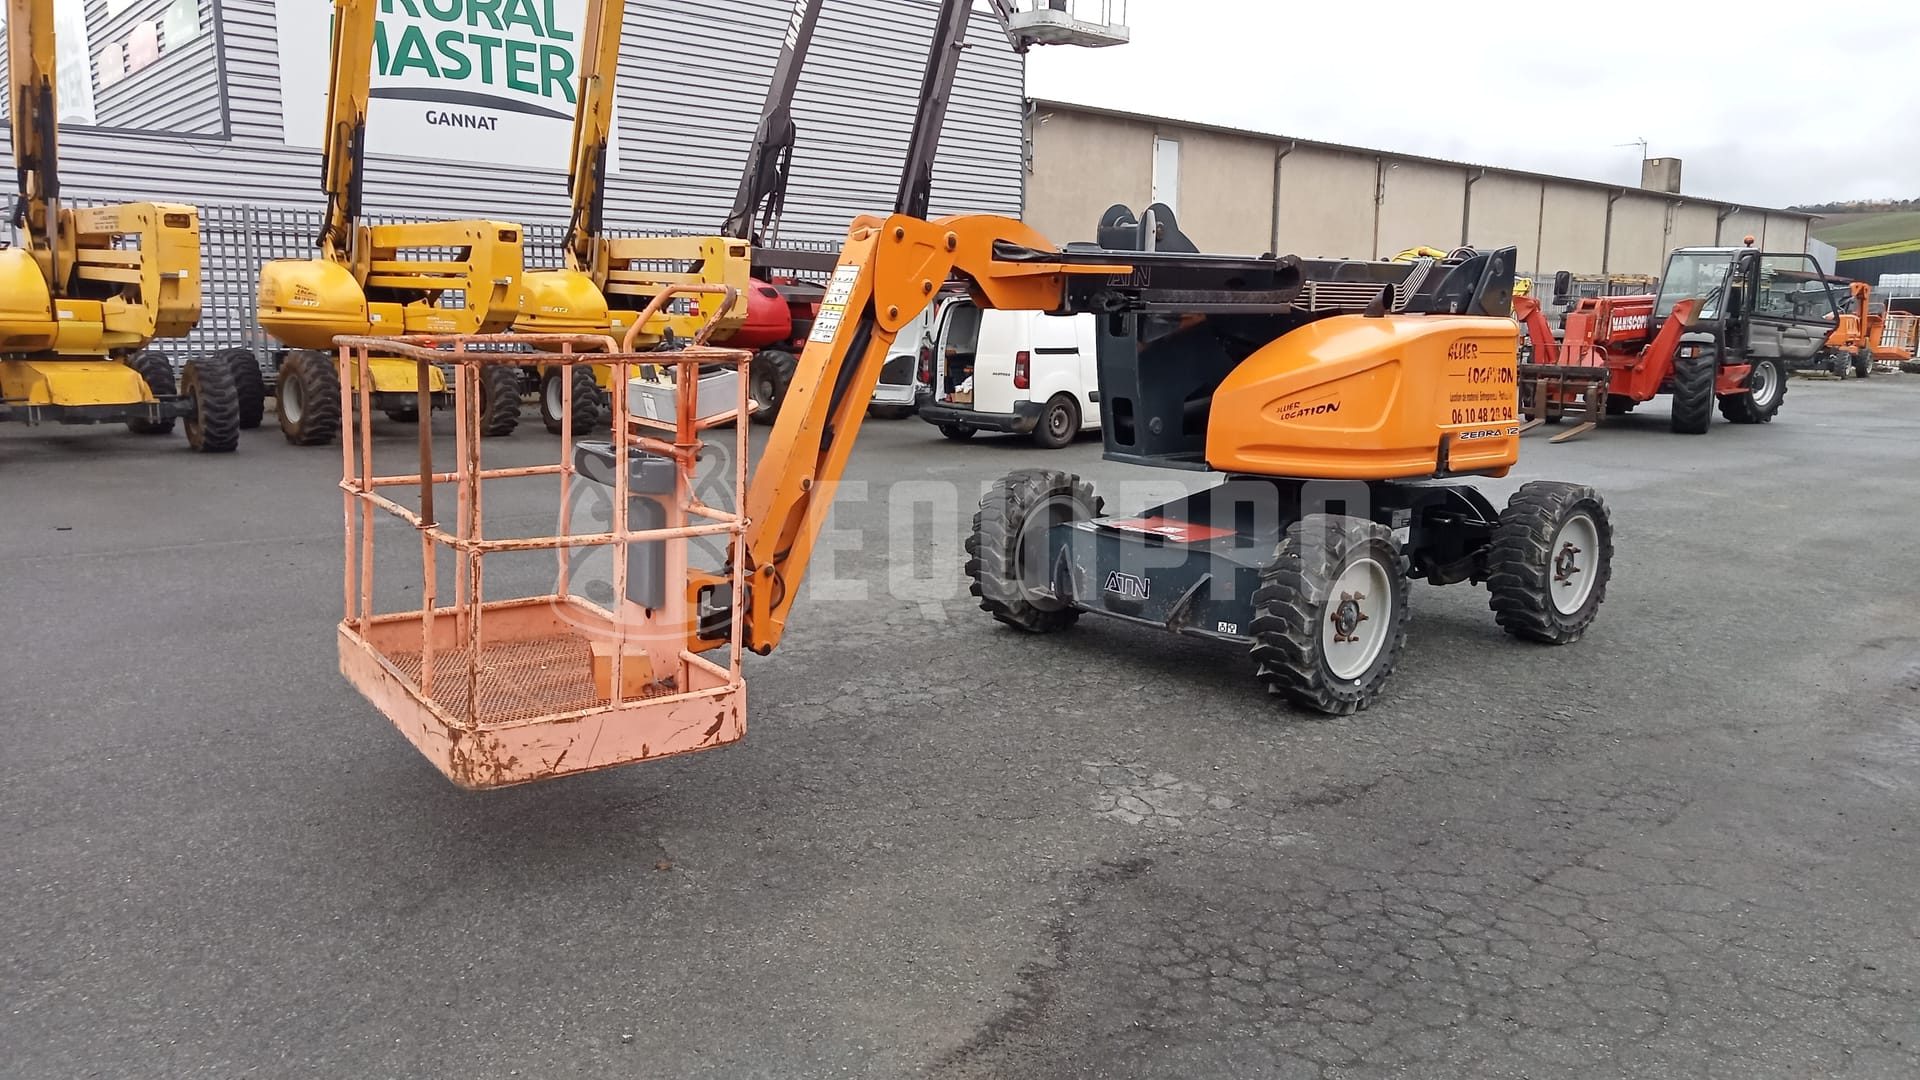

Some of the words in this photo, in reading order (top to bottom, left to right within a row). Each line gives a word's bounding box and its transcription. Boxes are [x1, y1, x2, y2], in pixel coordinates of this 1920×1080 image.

[425, 110, 498, 131] GANNAT
[1447, 342, 1478, 361] ALLIER
[1276, 401, 1301, 413] ALLIER
[1280, 400, 1341, 420] LOCATION
[1451, 408, 1463, 424] 06
[1465, 407, 1476, 423] 10
[1477, 407, 1488, 422] 48
[1502, 406, 1512, 420] 94
[1459, 429, 1502, 441] ZEBRA
[1506, 426, 1519, 436] 12
[1104, 570, 1150, 600] ATN
